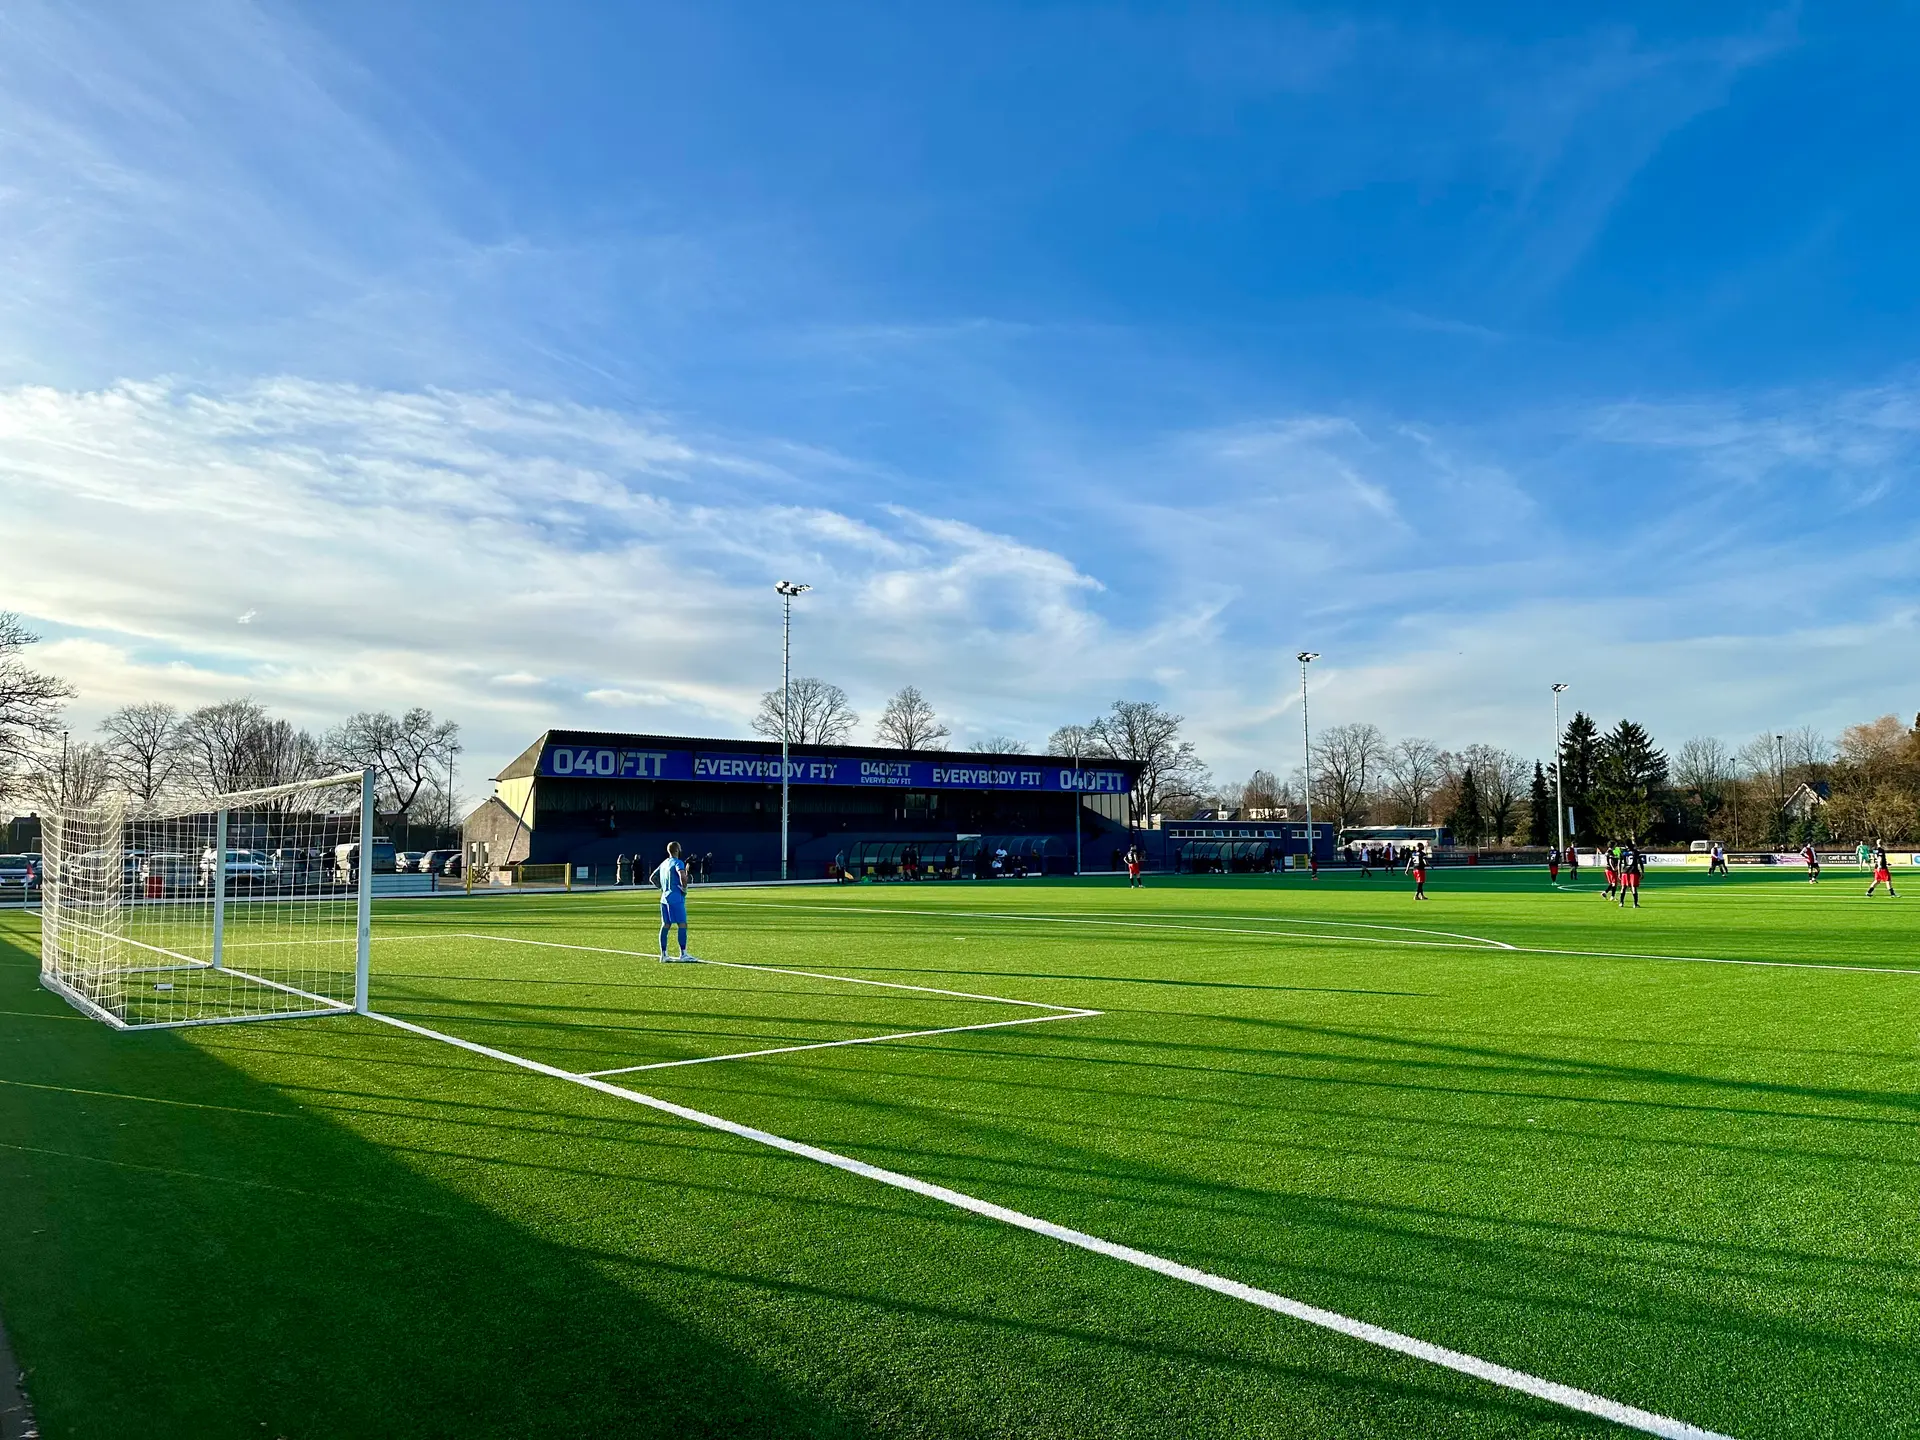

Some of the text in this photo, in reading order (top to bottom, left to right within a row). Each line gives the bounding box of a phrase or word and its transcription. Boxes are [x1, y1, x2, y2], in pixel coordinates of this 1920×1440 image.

[553, 748, 667, 776] 040FIT
[694, 758, 838, 779] EVERYBODY FIT
[860, 776, 911, 785] EVERYBODY FIT
[932, 768, 1041, 785] EVERYBODY FIT
